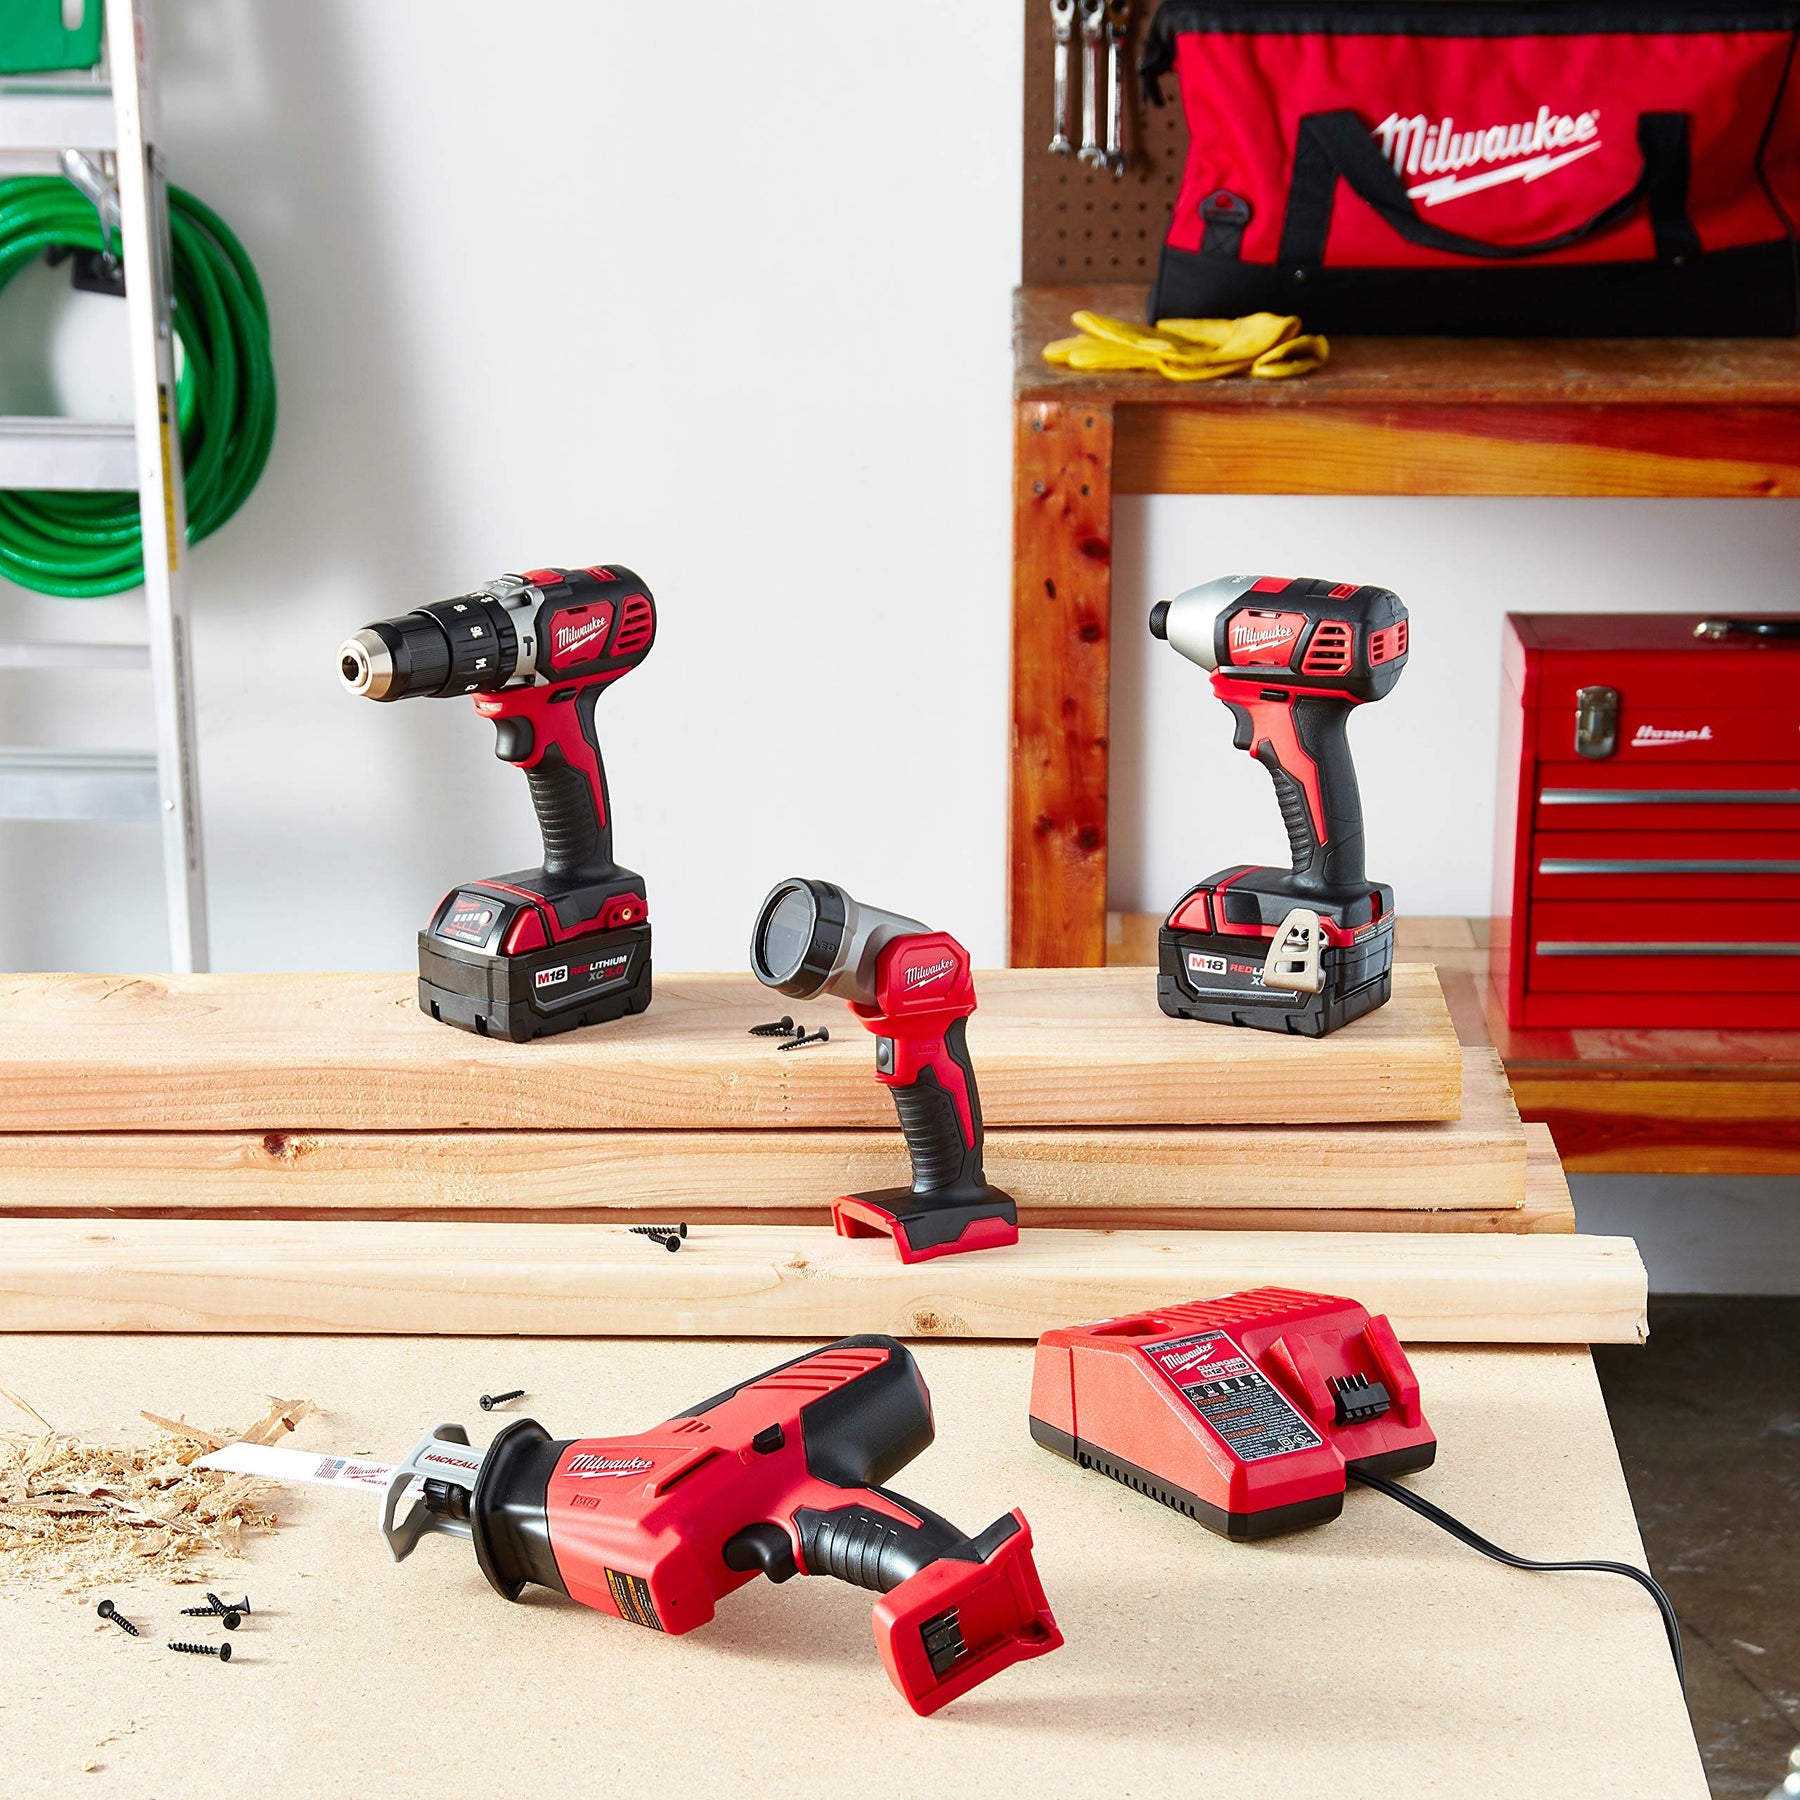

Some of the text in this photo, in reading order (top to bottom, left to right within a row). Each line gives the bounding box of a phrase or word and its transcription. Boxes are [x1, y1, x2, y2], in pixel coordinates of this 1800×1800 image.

[1370, 105, 1599, 176] Milwaukee
[555, 615, 606, 648] Milwaukee
[1230, 624, 1293, 647] Milwaukee
[475, 657, 488, 670] 14
[903, 959, 954, 985] Milwaukee
[1191, 956, 1265, 976] M18 REDLI
[537, 968, 566, 985] M18
[1159, 1343, 1215, 1370] Milwaukee
[1196, 1357, 1244, 1371] CHARGER
[1202, 1367, 1224, 1377] M12
[343, 1465, 390, 1476] Milwaukee
[425, 1453, 480, 1471] HACKZALL
[566, 1453, 654, 1471] Milwaukee
